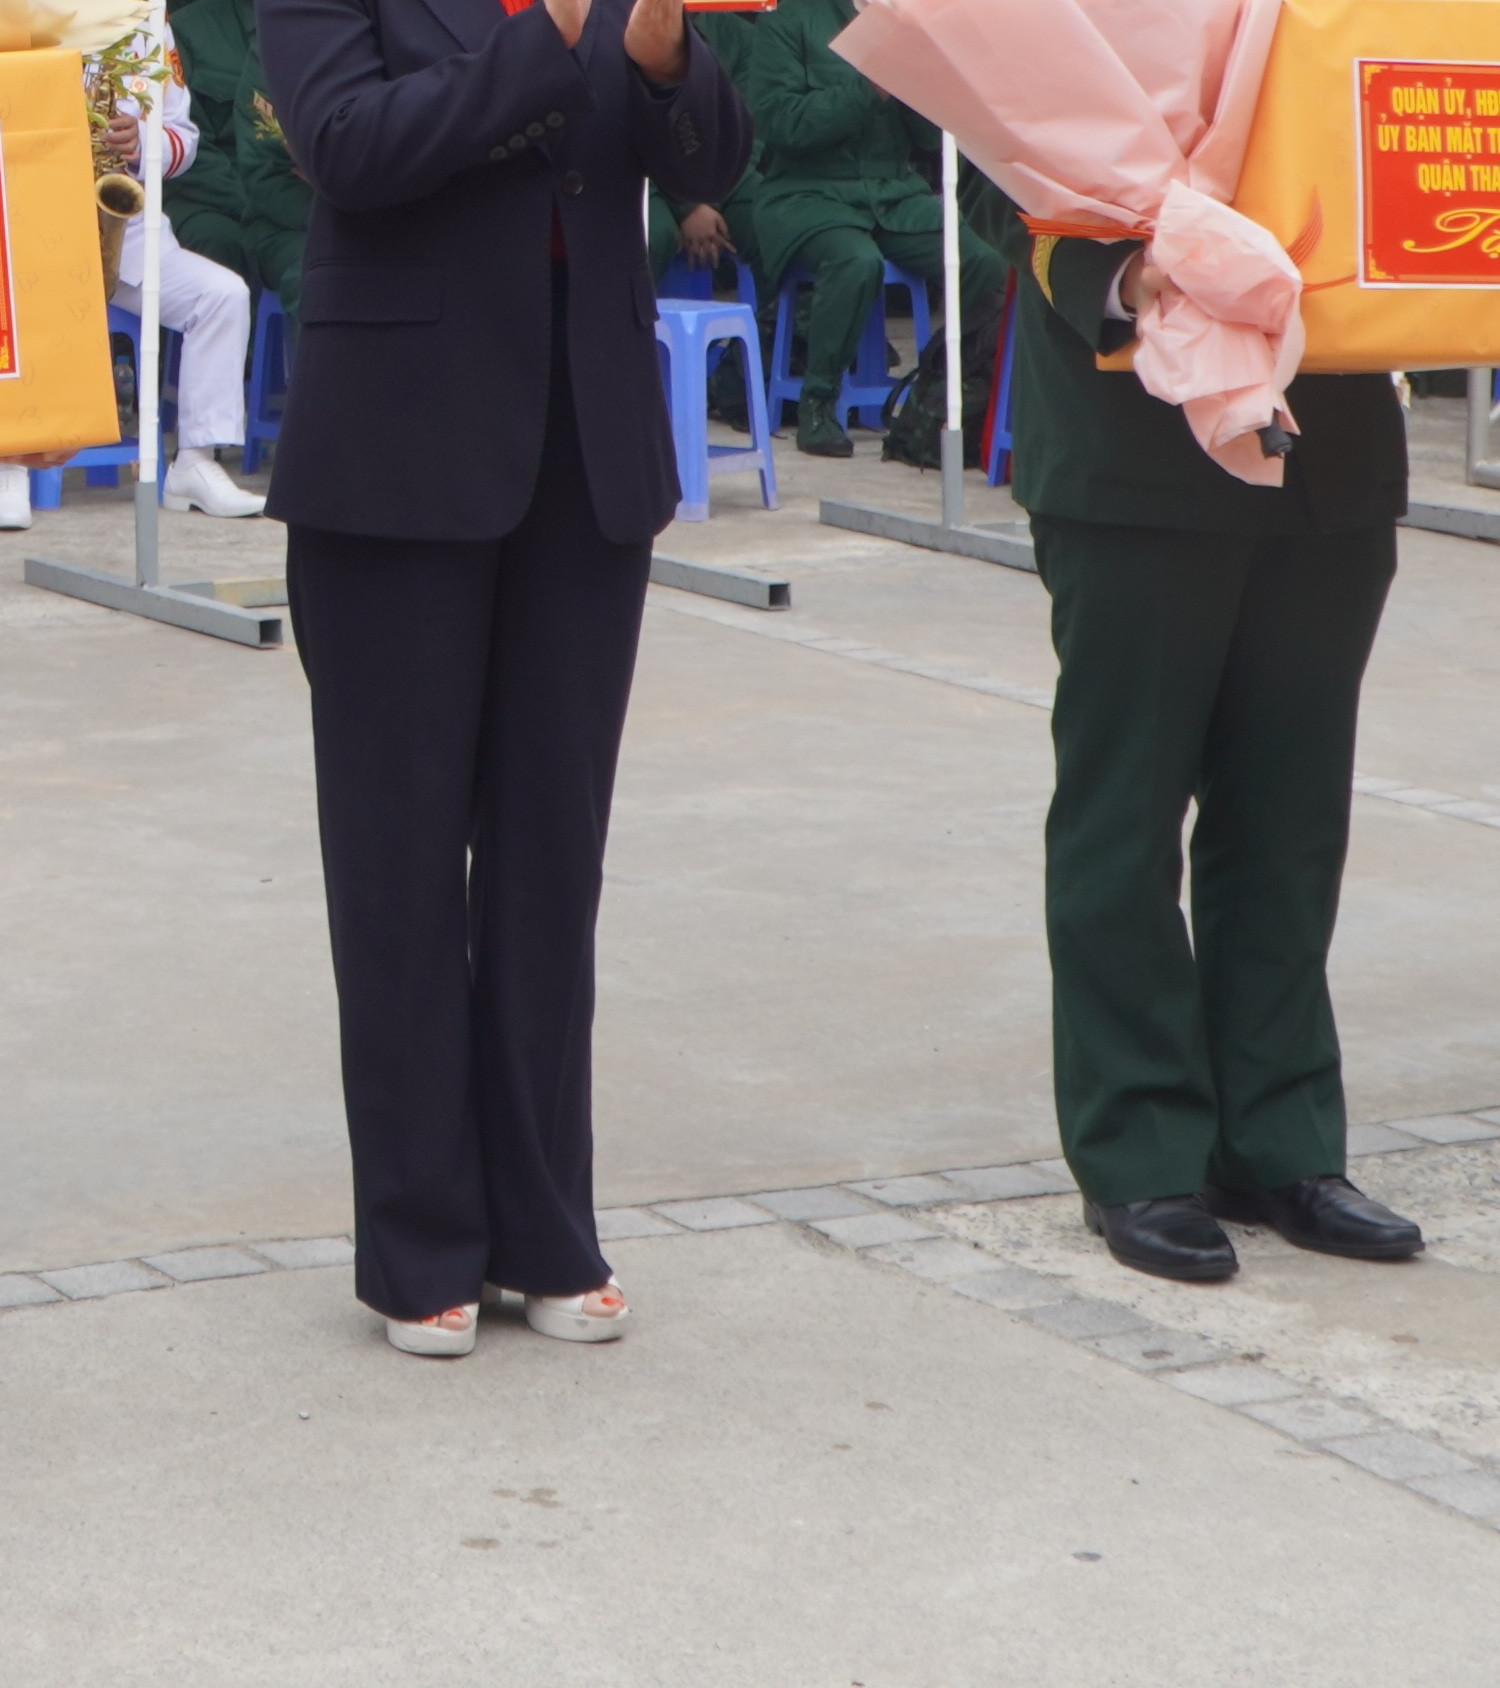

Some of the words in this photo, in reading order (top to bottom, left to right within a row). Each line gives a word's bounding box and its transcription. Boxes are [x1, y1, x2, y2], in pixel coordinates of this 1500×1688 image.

[1392, 82, 1439, 120] QUẬN
[1444, 77, 1472, 118] ỦY,
[1378, 113, 1400, 151] ỦY
[1406, 125, 1442, 152] BAN
[1447, 121, 1482, 159] MẶT
[1418, 159, 1466, 197] QUẬN
